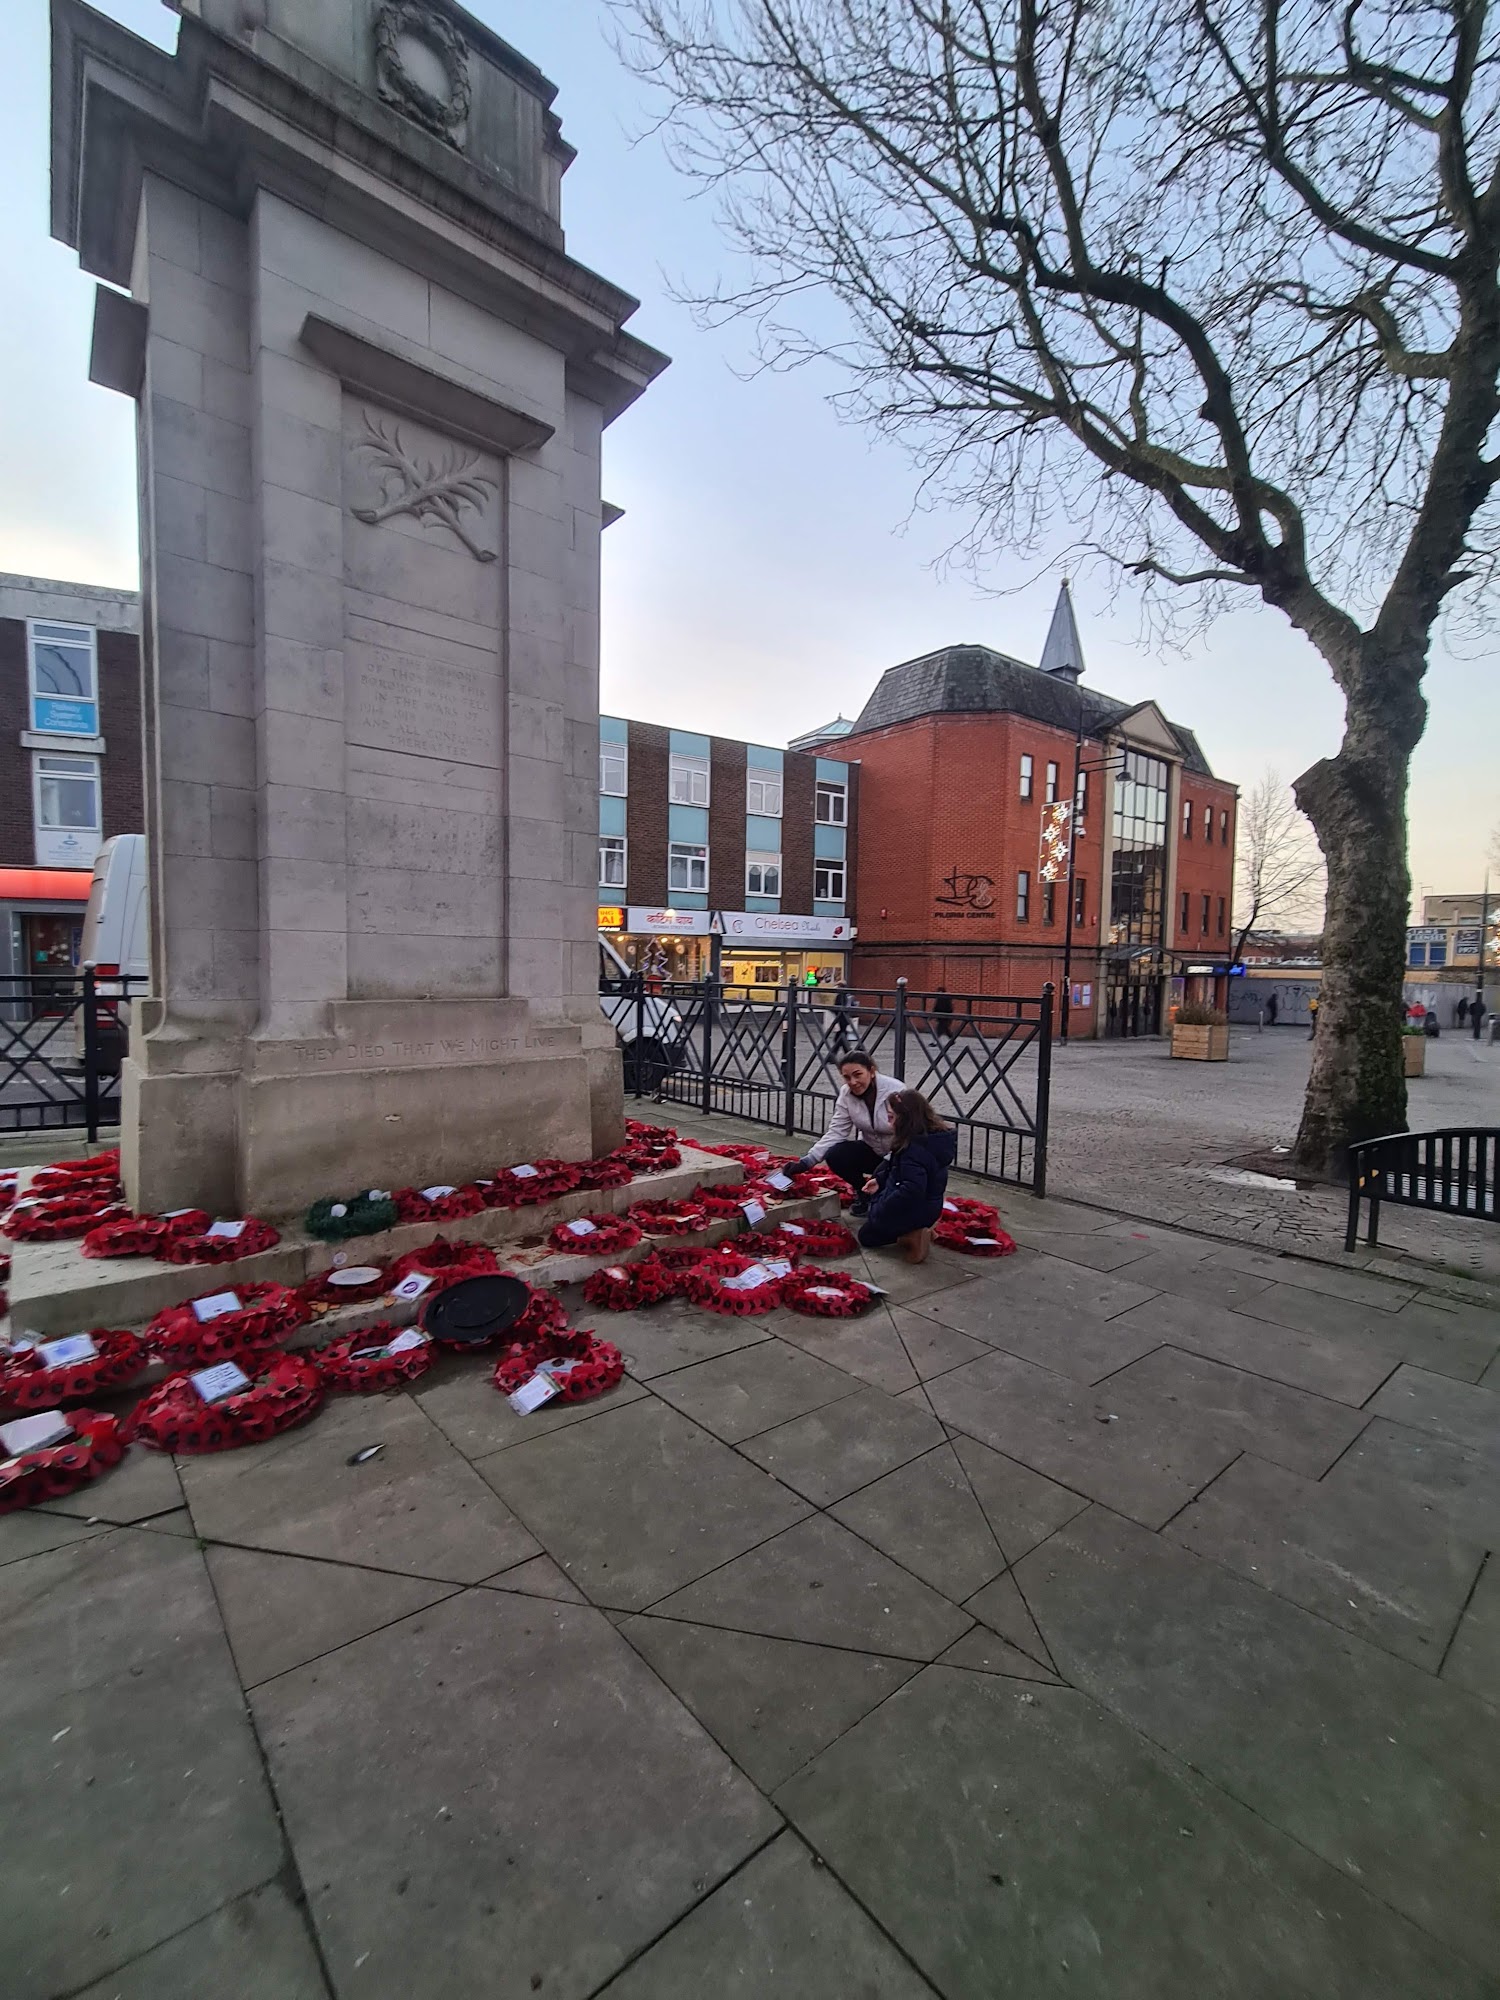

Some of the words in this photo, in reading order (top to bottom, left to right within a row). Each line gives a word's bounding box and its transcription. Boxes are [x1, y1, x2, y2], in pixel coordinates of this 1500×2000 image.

[754, 917, 798, 930] Chelsea
[293, 1046, 340, 1061] THEY
[347, 1044, 385, 1059] DIED
[392, 1041, 435, 1056] THAT
[439, 1039, 465, 1052] WE
[471, 1038, 519, 1052] MIGHT
[525, 1035, 555, 1049] LIVE
